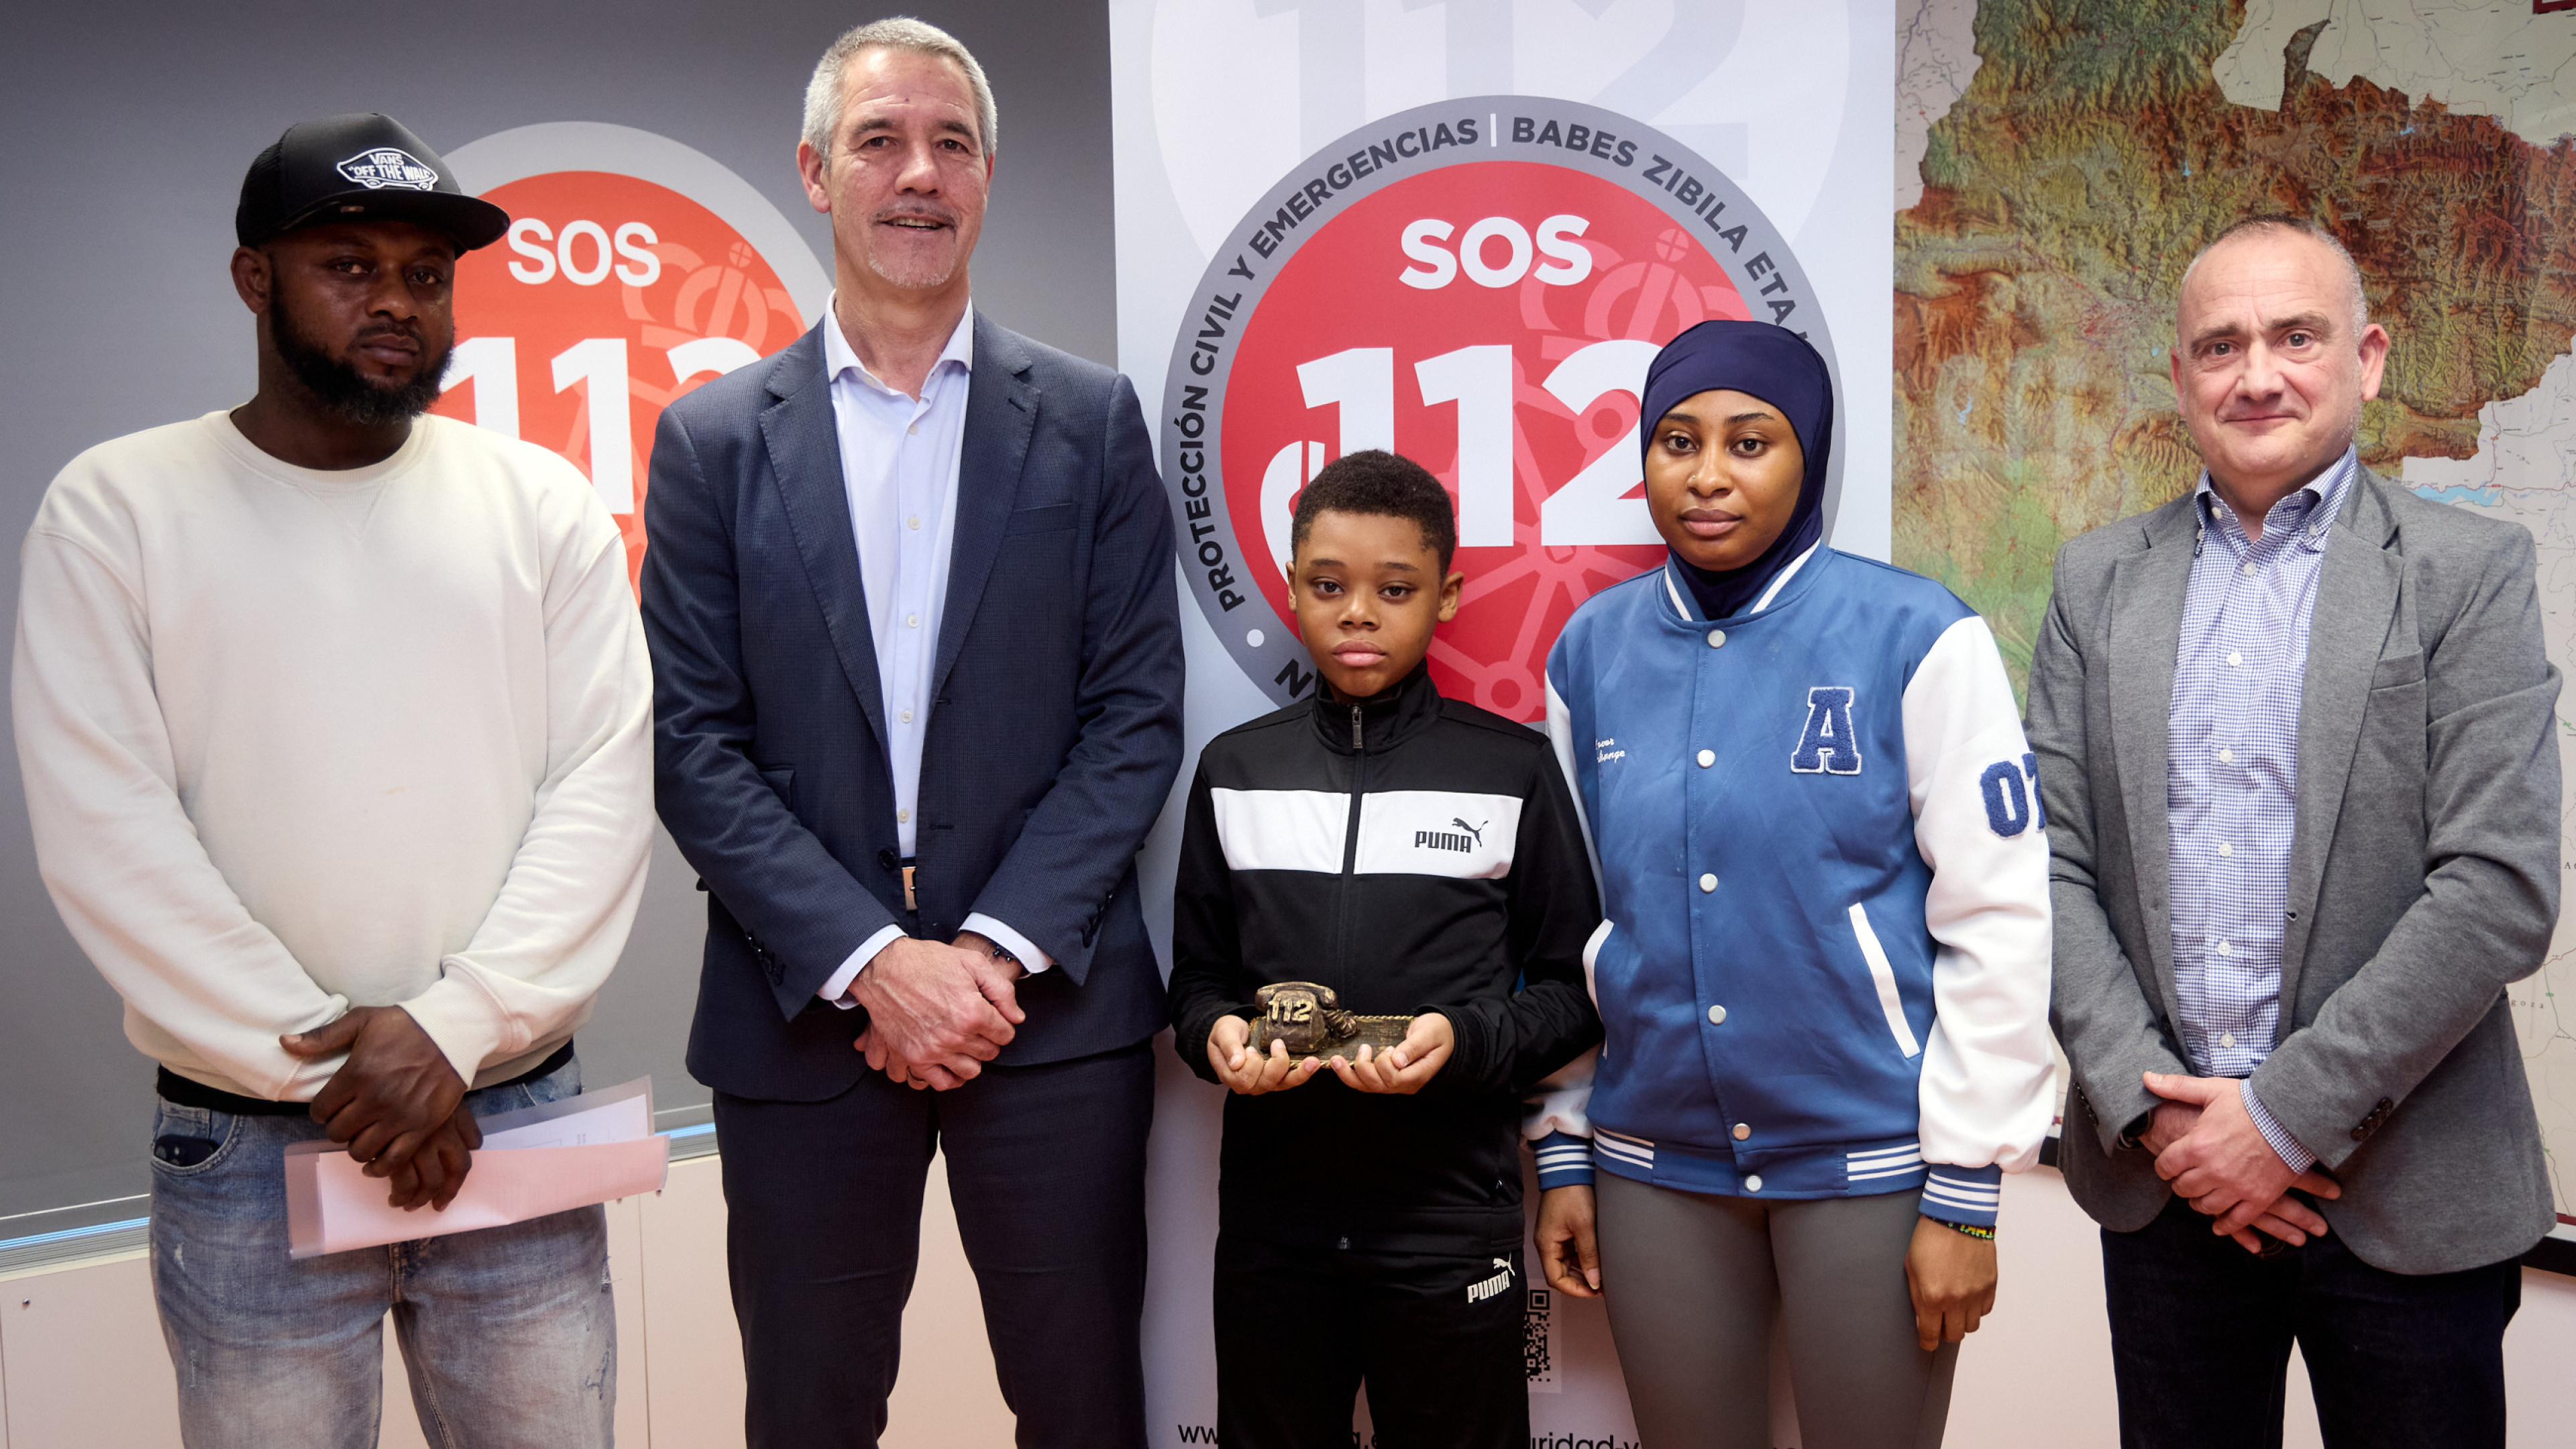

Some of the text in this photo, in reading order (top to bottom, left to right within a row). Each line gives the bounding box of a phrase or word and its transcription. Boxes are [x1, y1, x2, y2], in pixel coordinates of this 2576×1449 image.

[368, 153, 404, 165] VANS
[376, 165, 404, 180] THE
[508, 217, 661, 286] SOS
[1399, 215, 1593, 290] SOS
[1512, 117, 1796, 326] BABES ZIBILA ETA
[1174, 118, 1479, 612] PROTECCIÓN CIVIL Y EMERGENCIAS
[438, 337, 762, 515] 11
[1296, 339, 1666, 547] 112
[1790, 686, 1862, 775] A
[1414, 830, 1472, 853] PUMA
[1267, 998, 1313, 1024] 112
[1467, 1270, 1510, 1303] PUMA
